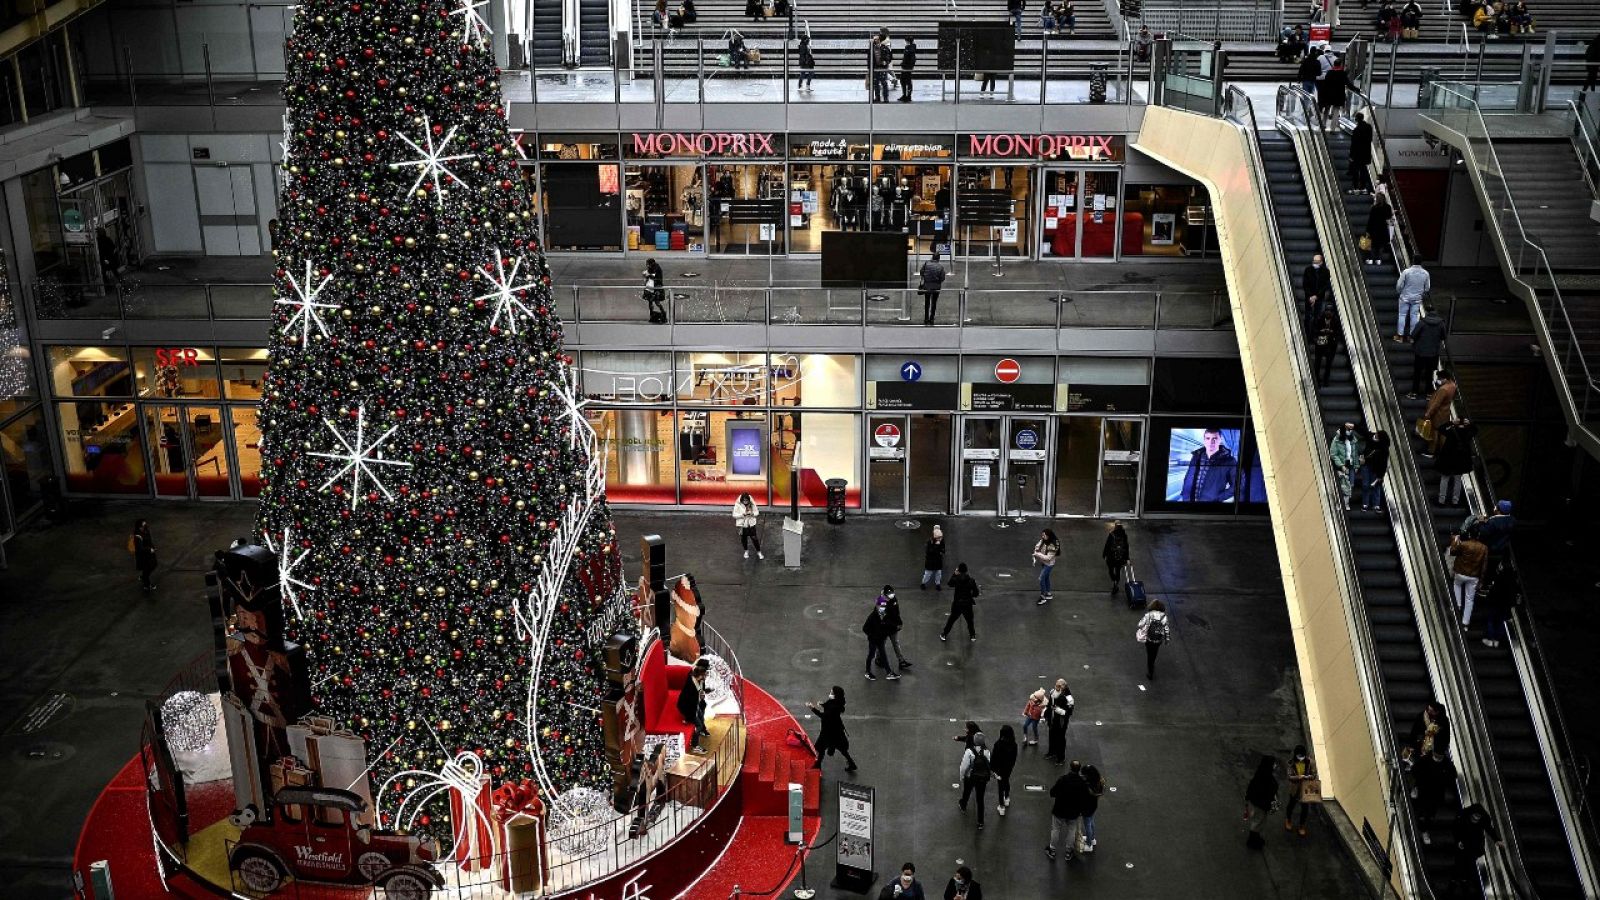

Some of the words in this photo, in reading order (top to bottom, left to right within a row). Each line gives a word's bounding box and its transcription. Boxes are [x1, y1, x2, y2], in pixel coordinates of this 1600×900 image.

[632, 133, 774, 155] MONOPRIX
[811, 138, 835, 147] mode
[884, 143, 942, 153] alimentation
[969, 134, 1113, 156] MONOPRIX
[155, 347, 200, 368] SFR
[293, 845, 343, 863] Westfield
